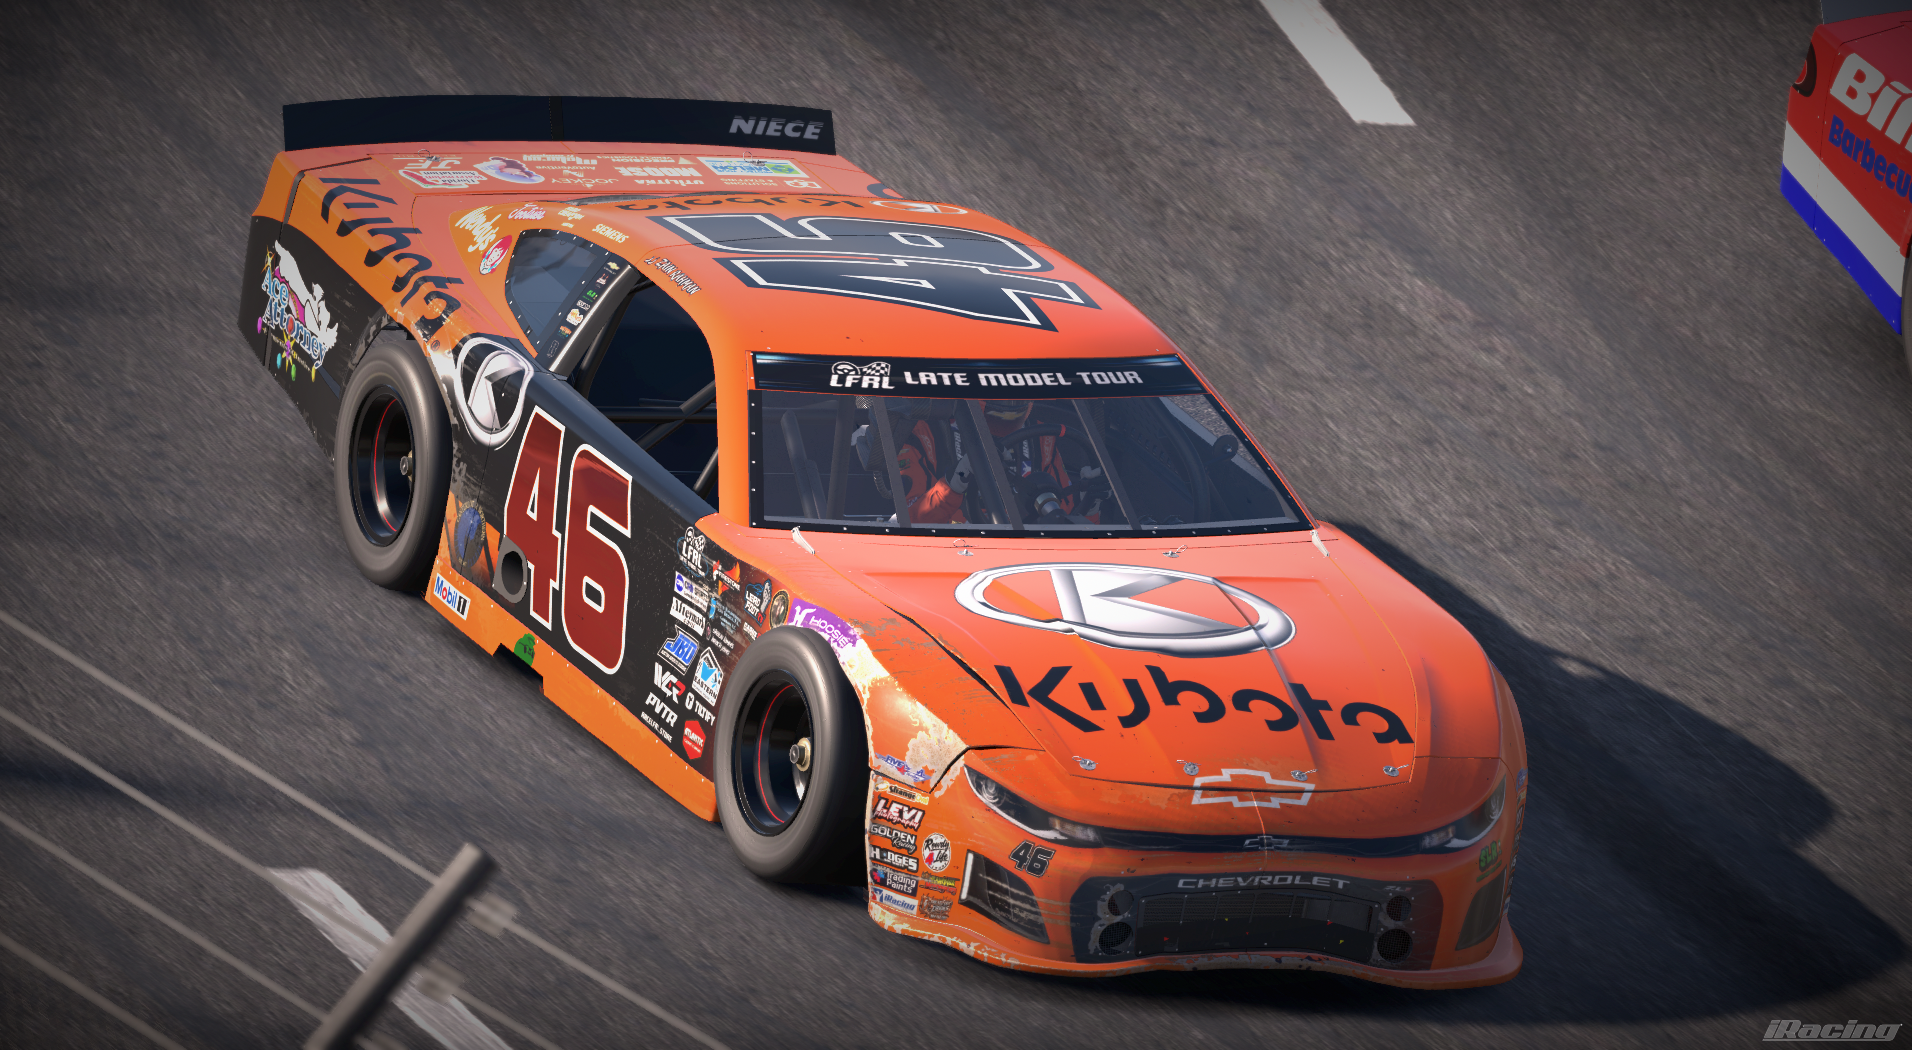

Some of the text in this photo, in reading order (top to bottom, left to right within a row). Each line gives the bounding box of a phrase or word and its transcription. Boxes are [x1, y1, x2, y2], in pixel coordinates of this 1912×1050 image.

[728, 115, 824, 140] NIECE
[613, 166, 703, 177] MOOSE
[1828, 114, 1912, 204] Barbecu
[592, 223, 630, 244] SIEMENS
[319, 177, 464, 344] Kubota
[261, 266, 289, 307] Ace
[262, 298, 327, 369] Attorney
[829, 374, 895, 390] LFRL
[903, 370, 1144, 387] LATE MODEL TOUR
[503, 405, 632, 675] 46
[681, 541, 703, 570] LFRL
[435, 576, 467, 616] Mobil 1
[808, 615, 850, 650] HOOSIE
[693, 675, 718, 700] EASTERN
[645, 692, 679, 728] PVTR
[993, 664, 1415, 745] Kubota
[875, 798, 925, 825] LEVI
[871, 822, 917, 845] GOLDEN
[1009, 840, 1057, 878] 46
[886, 871, 917, 888] Trading
[886, 879, 914, 895] Paints
[1177, 873, 1351, 891] CHEVROLET
[884, 893, 917, 912] iRacing
